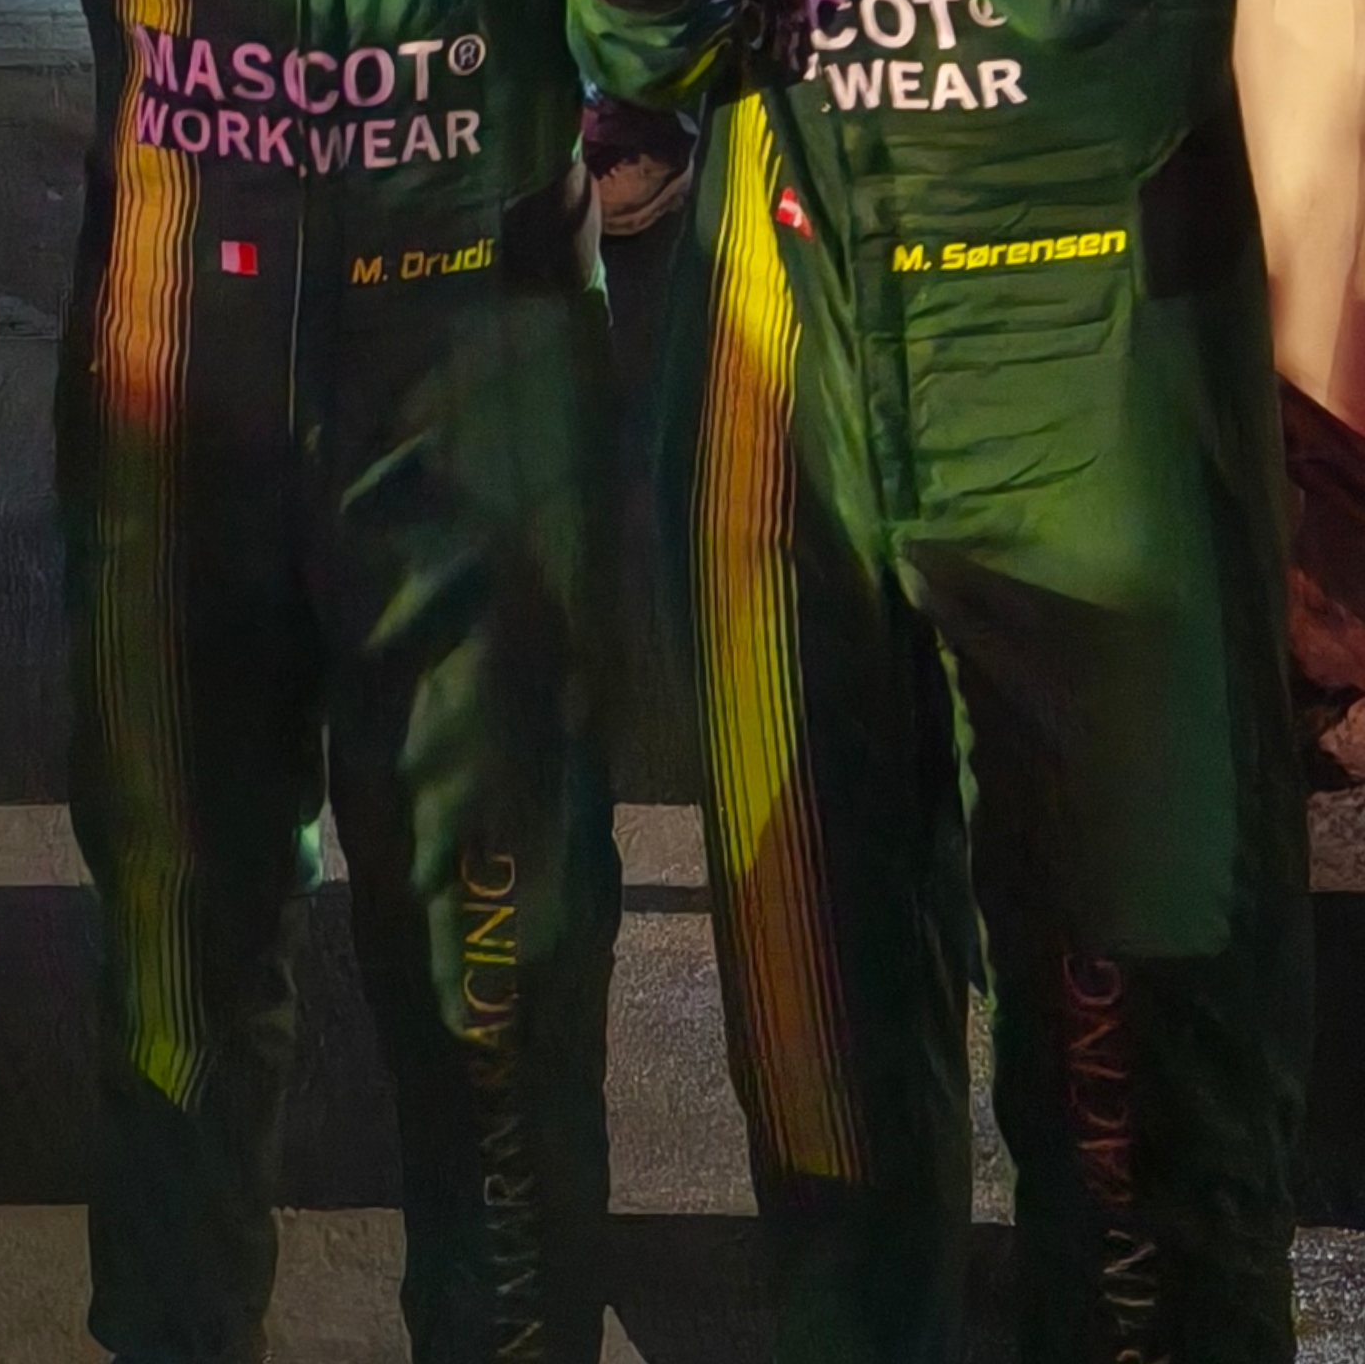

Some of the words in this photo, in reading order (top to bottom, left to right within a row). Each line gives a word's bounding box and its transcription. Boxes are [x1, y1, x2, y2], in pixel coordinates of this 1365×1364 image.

[350, 255, 388, 286] M.
[400, 238, 497, 281] Drudi
[891, 243, 933, 273] M.
[941, 229, 1127, 271] Sørensen
